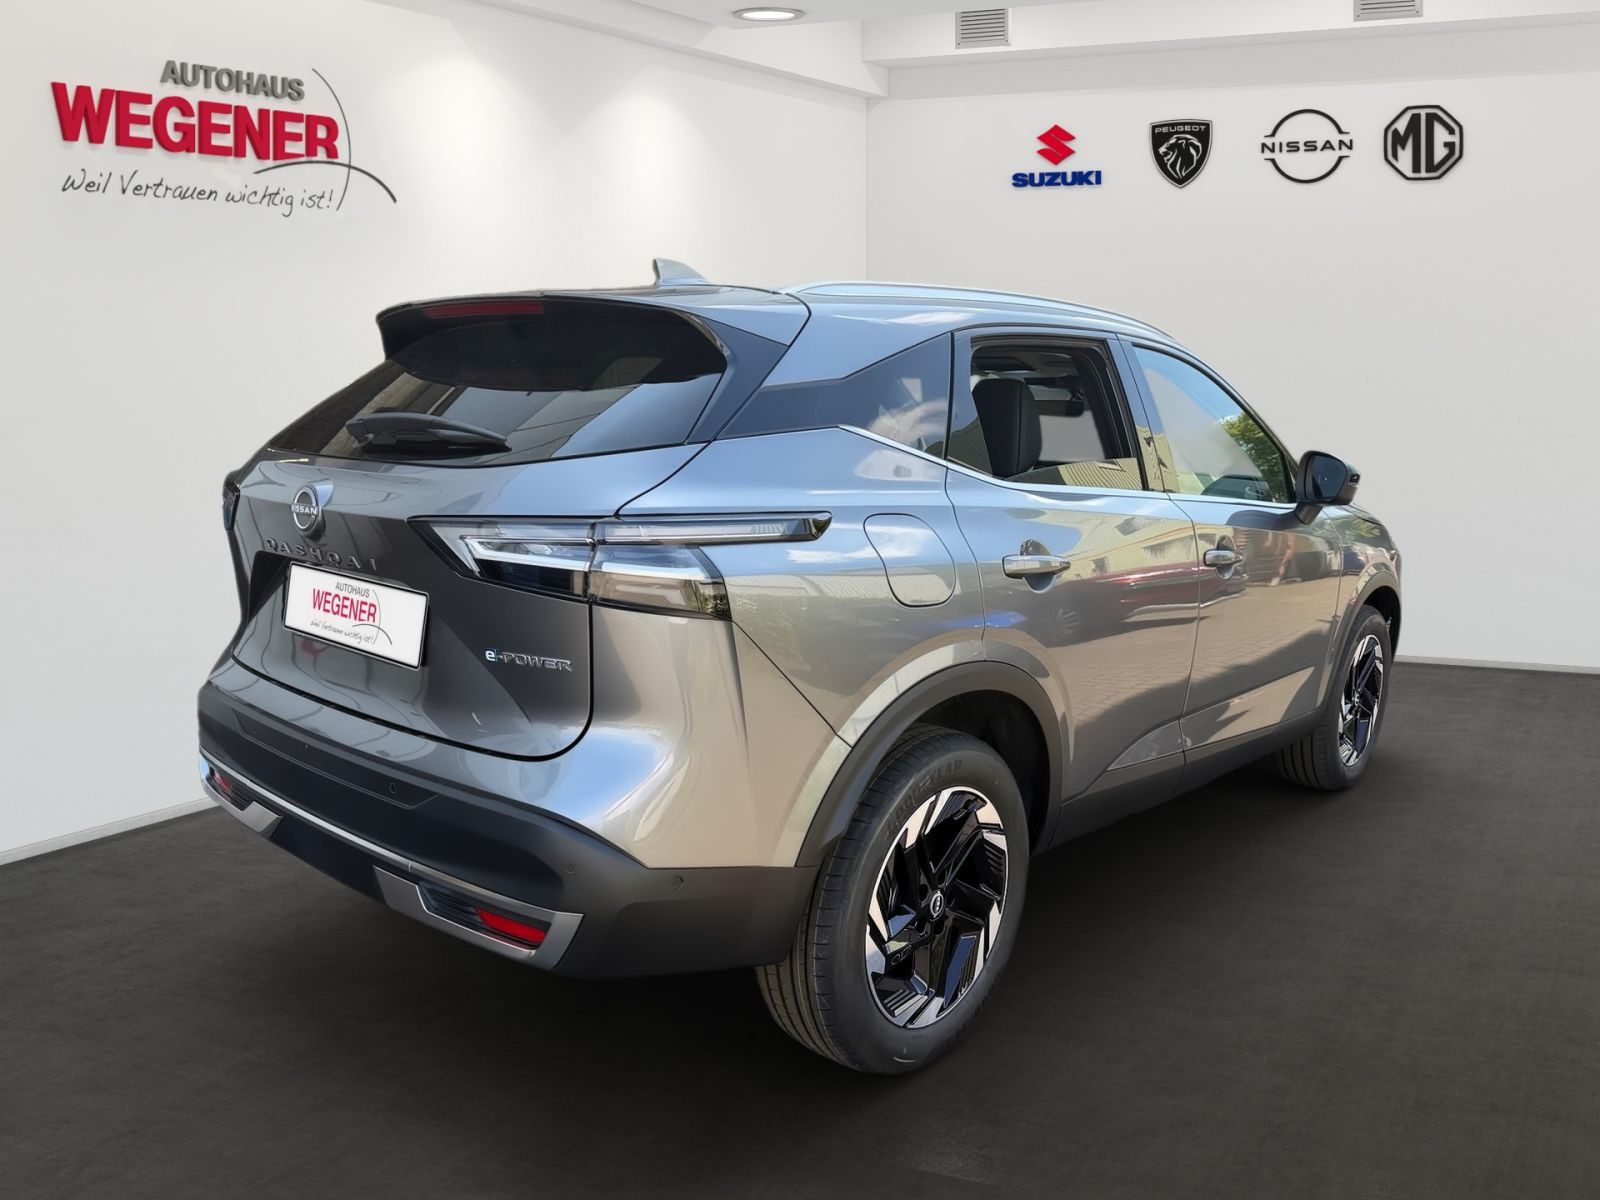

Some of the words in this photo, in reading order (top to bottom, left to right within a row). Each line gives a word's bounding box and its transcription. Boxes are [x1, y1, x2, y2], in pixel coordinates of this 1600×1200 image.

[160, 60, 304, 101] AUTOHAUS
[51, 81, 339, 161] WEGENER
[1154, 125, 1207, 134] PEUGEOT
[1261, 139, 1353, 153] NISSAN
[1391, 112, 1456, 174] MG
[61, 168, 112, 193] Weil
[120, 169, 218, 202] Vertrauen
[225, 184, 294, 218] wichtig
[300, 188, 334, 209] ist!
[1012, 170, 1102, 188] SUZUKI
[265, 537, 377, 572] QASHQAI
[312, 588, 377, 623] WEGENER
[335, 582, 370, 599] AUTOHAUS
[485, 649, 572, 672] e-POWER
